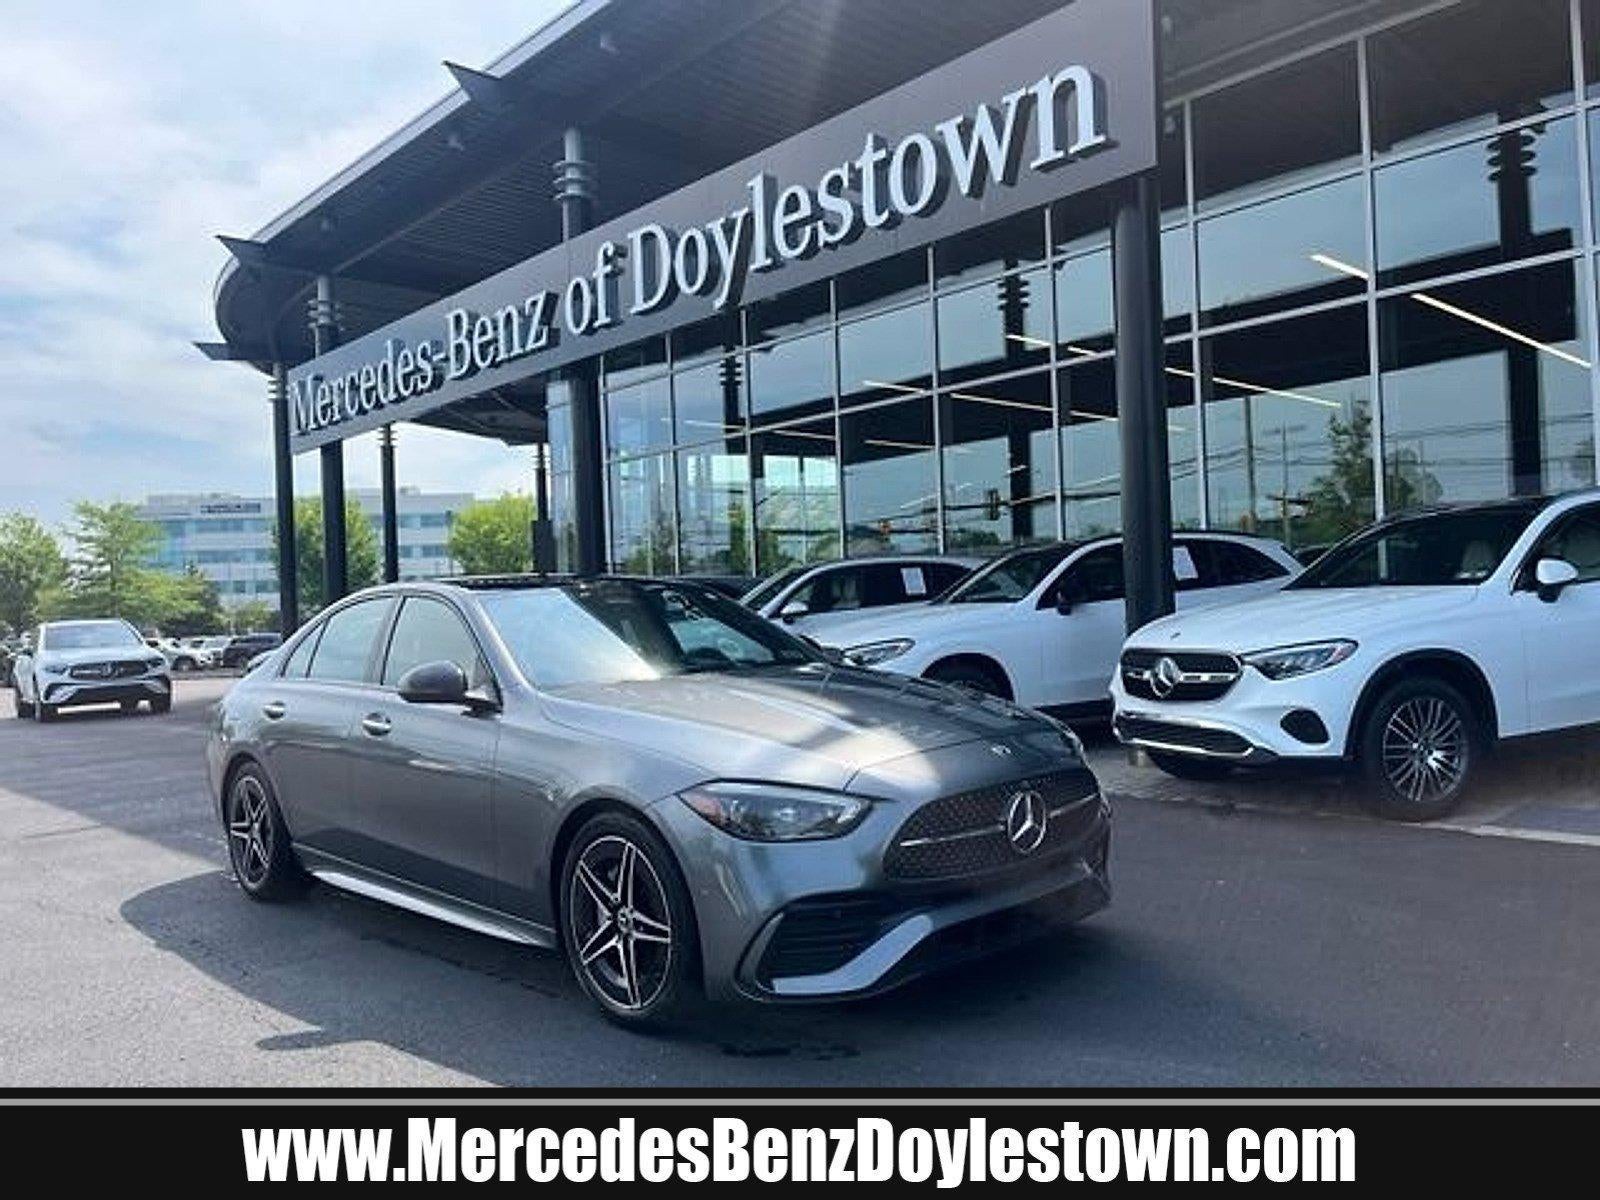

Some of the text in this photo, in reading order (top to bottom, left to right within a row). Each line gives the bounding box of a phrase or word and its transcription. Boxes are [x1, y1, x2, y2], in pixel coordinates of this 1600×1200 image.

[288, 63, 1108, 435] Mercedes-Benz of Doylestown
